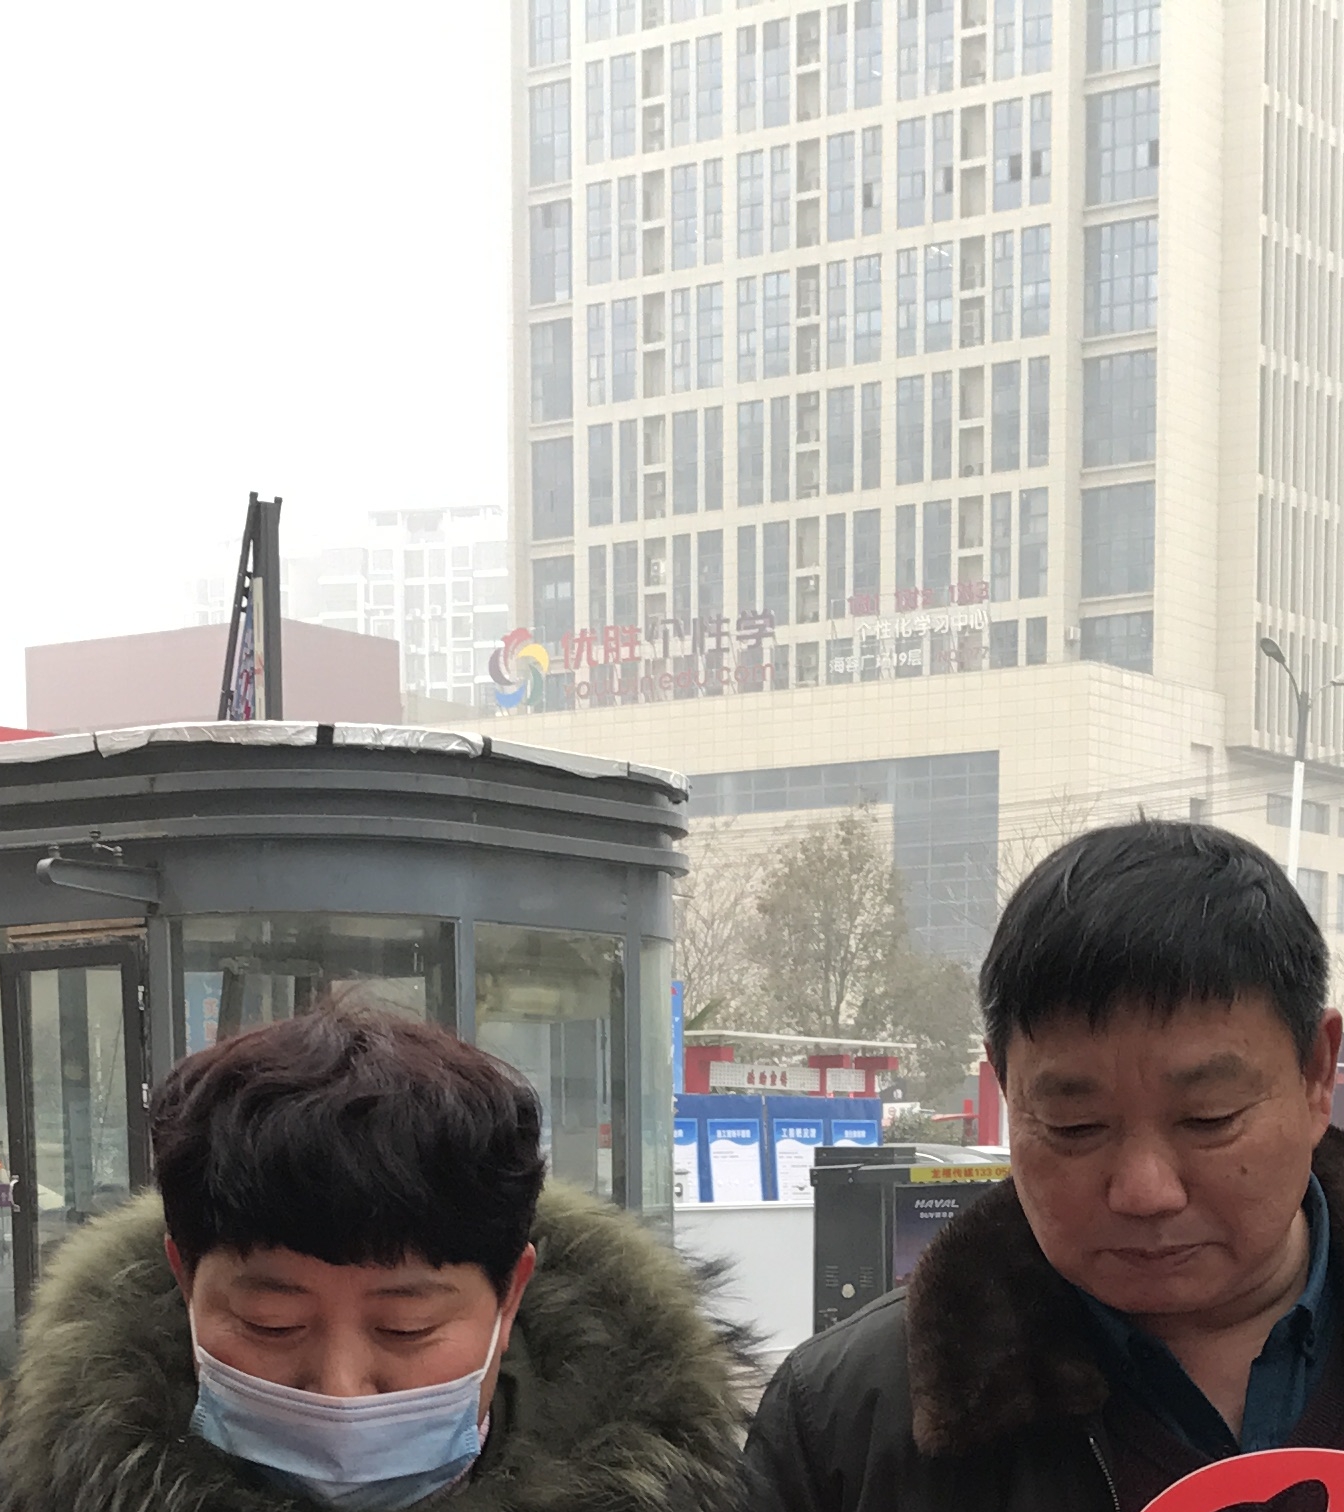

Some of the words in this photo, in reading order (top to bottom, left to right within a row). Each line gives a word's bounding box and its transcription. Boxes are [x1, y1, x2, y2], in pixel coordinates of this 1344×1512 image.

[857, 609, 989, 641] 个性化学习中心
[915, 1199, 959, 1208] HAVAL
